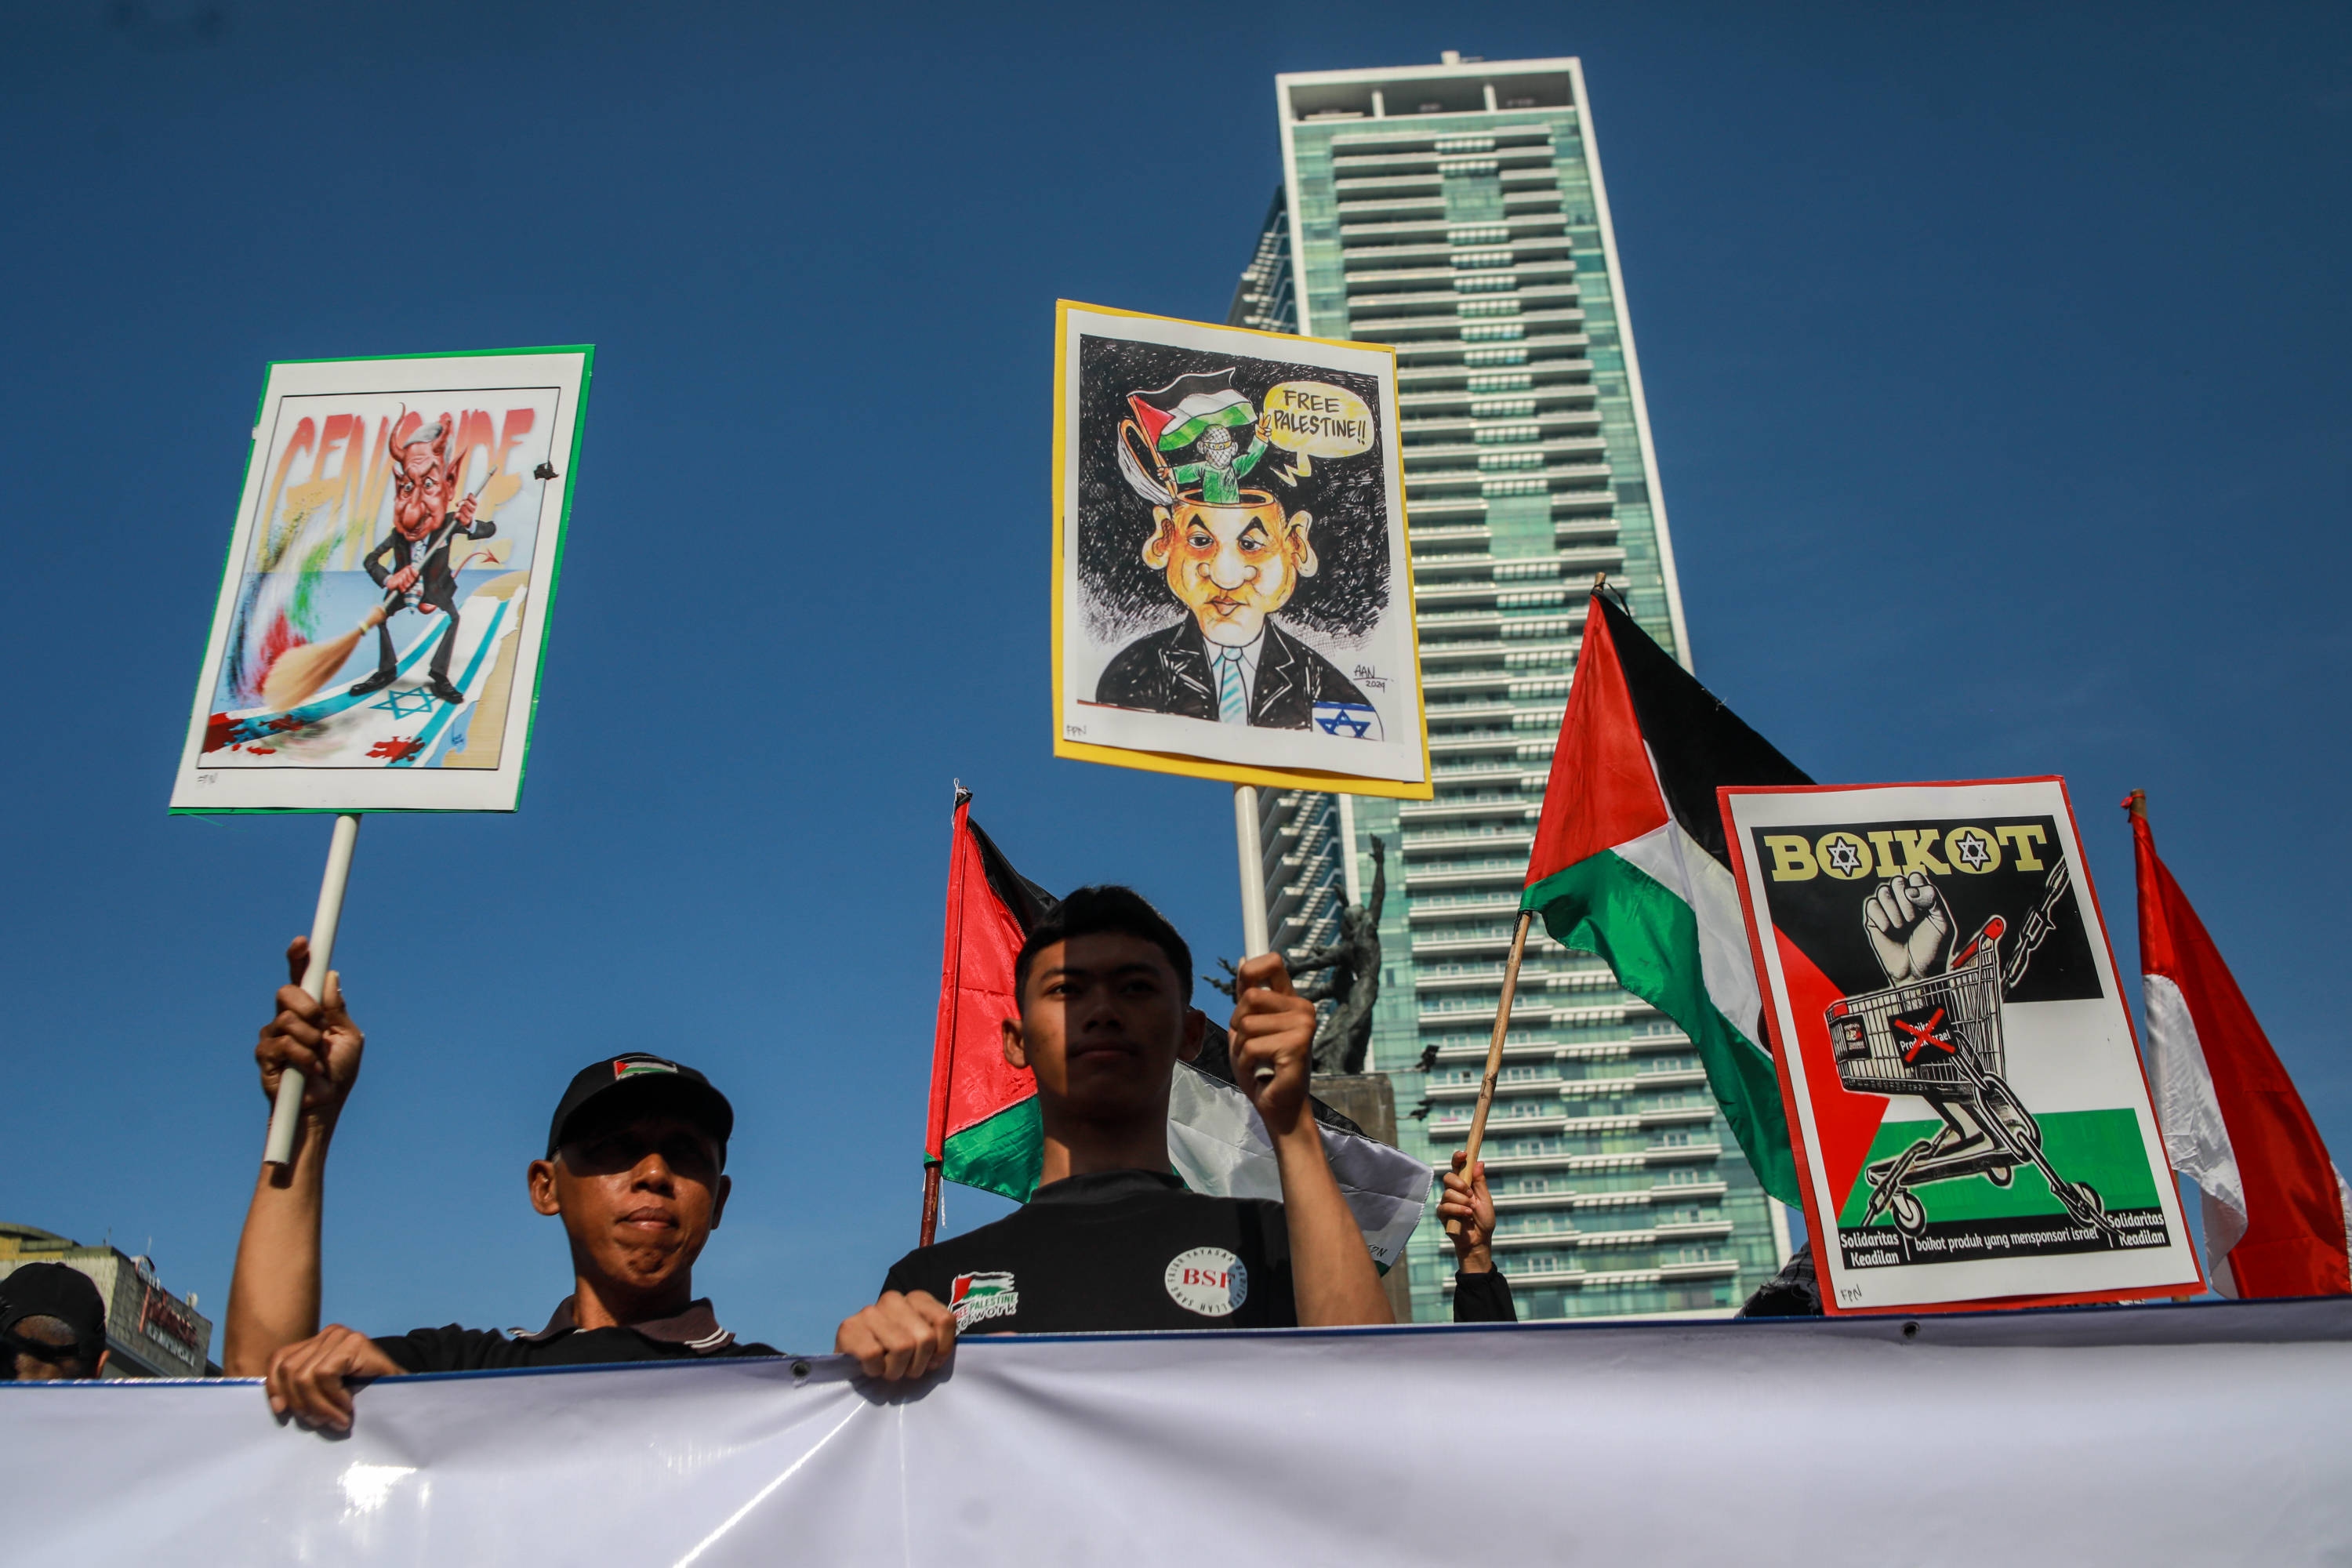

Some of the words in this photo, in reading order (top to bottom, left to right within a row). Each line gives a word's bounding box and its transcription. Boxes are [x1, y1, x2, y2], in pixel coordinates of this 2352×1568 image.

[1283, 390, 1340, 413] FREE
[1273, 409, 1367, 445] PALESTINE!!
[1763, 824, 2048, 882] BOIKOT
[2107, 1211, 2165, 1229] Solidaritas
[1840, 1231, 1900, 1248] Solidaritas
[1914, 1236, 1947, 1252] boikot
[1947, 1233, 1984, 1253] produk
[1984, 1234, 2010, 1250] yang
[2010, 1227, 2071, 1246] mensponsori
[2071, 1225, 2100, 1240] israel
[2118, 1229, 2166, 1247] Keadilan
[1849, 1249, 1900, 1267] Keadilan
[1183, 1268, 1236, 1289] BSF
[970, 1292, 1017, 1310] PALESTINE
[1840, 1283, 1863, 1302] FPN
